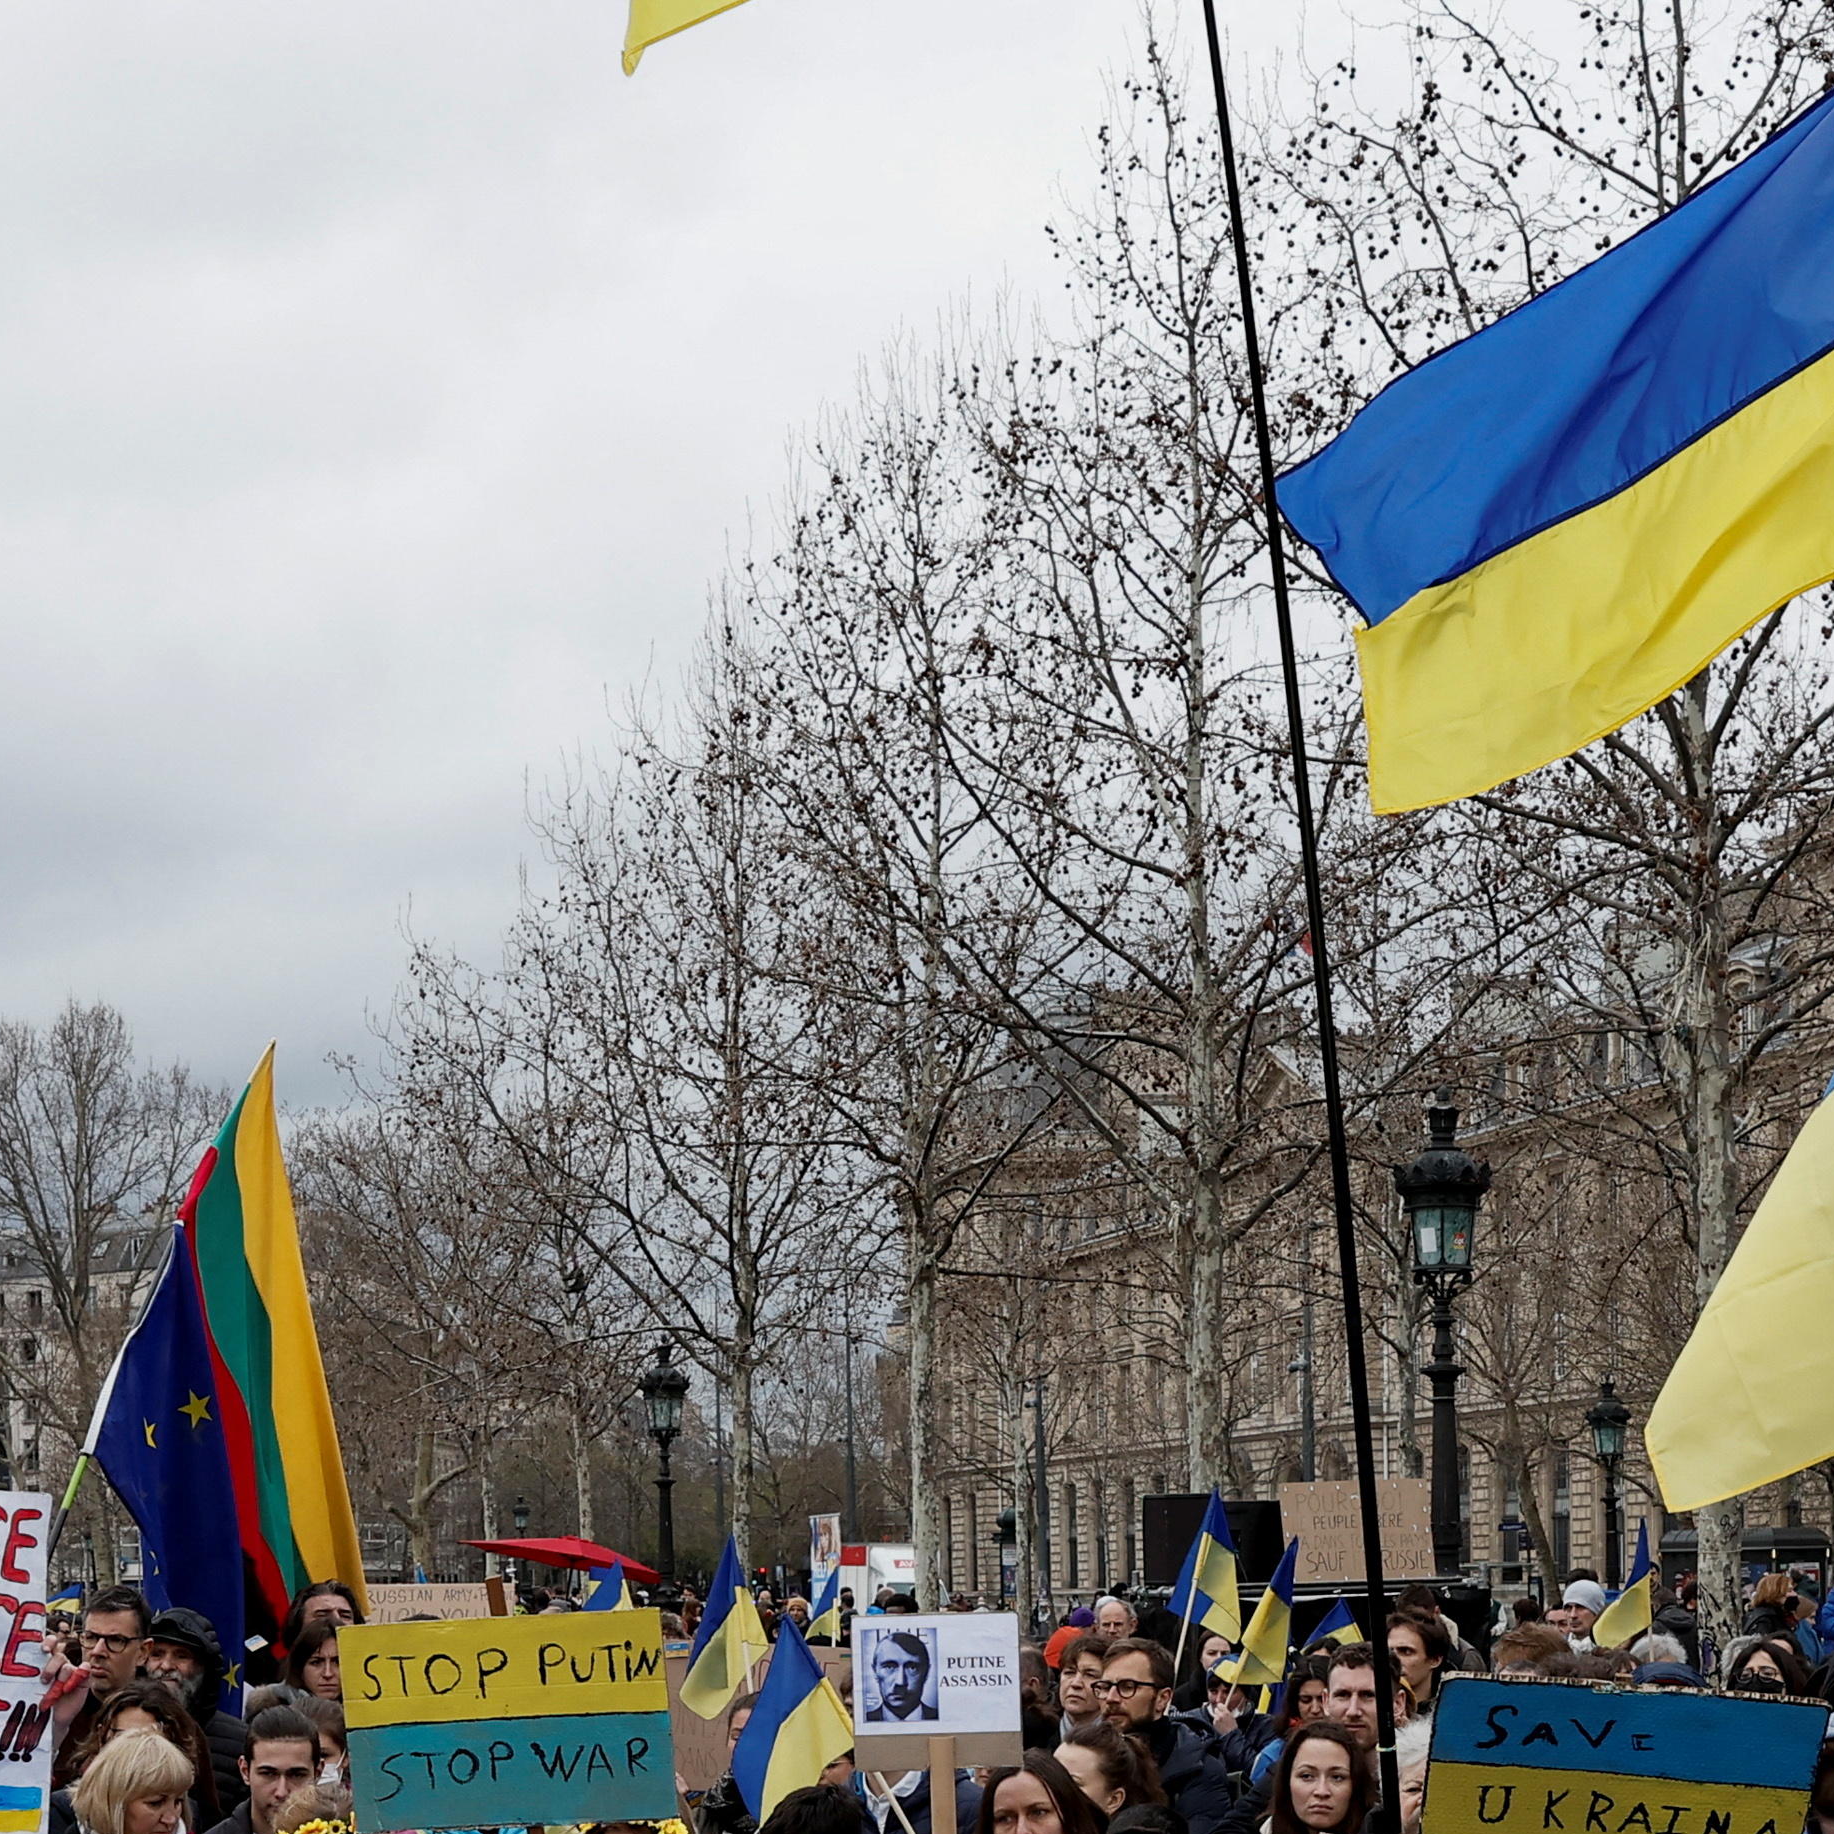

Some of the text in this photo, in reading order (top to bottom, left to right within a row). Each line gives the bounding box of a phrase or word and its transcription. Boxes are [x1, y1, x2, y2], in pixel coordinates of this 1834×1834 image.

[1313, 1513, 1358, 1530] PEUPLE
[1314, 1534, 1345, 1550] DANS
[1305, 1550, 1347, 1573] SAUF
[1380, 1549, 1429, 1571] RUSSIE
[367, 1588, 433, 1605] RUSSIAN
[947, 1656, 1006, 1669] PUTINE
[362, 1647, 508, 1701] STOP
[939, 1674, 1013, 1687] ASSASSIN
[374, 1737, 649, 1803] STOP WAR
